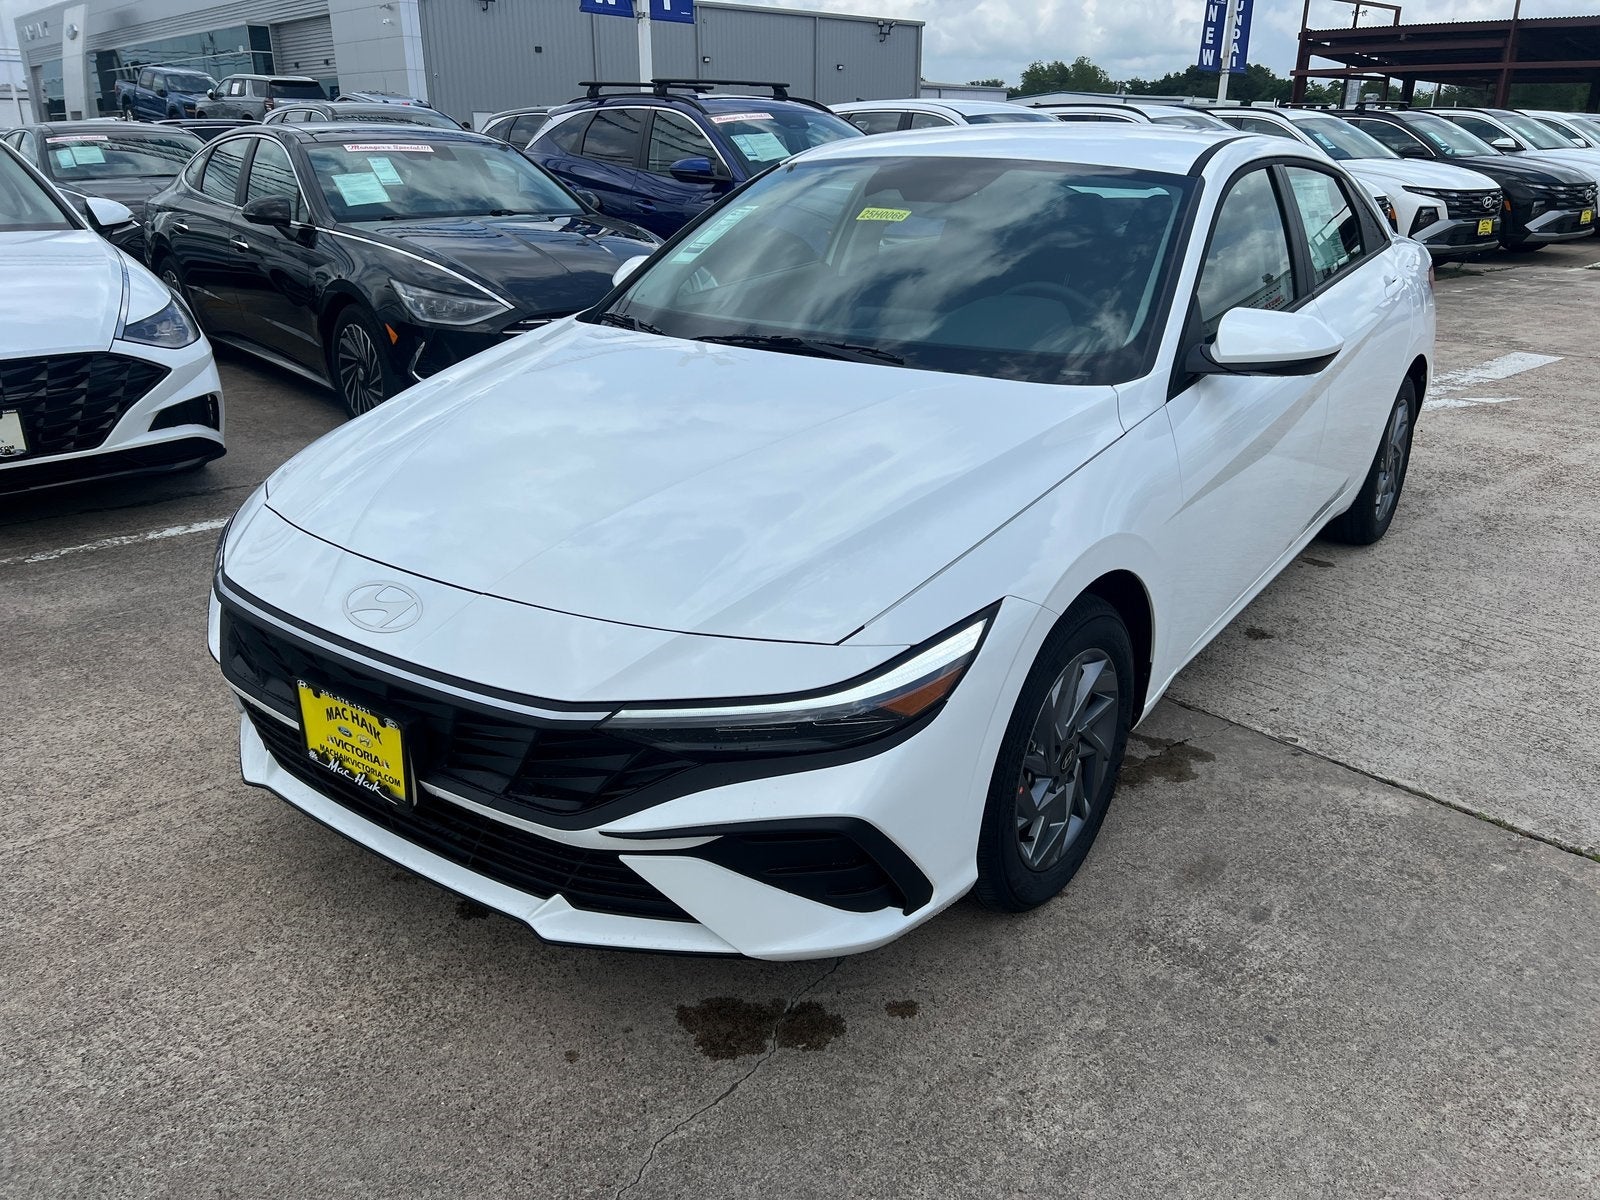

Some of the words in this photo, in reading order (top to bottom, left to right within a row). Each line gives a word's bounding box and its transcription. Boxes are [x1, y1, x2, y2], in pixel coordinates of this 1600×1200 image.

[1202, 4, 1218, 66] NEW
[325, 706, 349, 722] MAC
[350, 710, 382, 745] HAIK
[319, 744, 401, 787] MACHAIKVICTORIA.COM
[333, 737, 381, 766] VICTORIA
[328, 759, 351, 777] Mac
[354, 773, 382, 793] Haik
